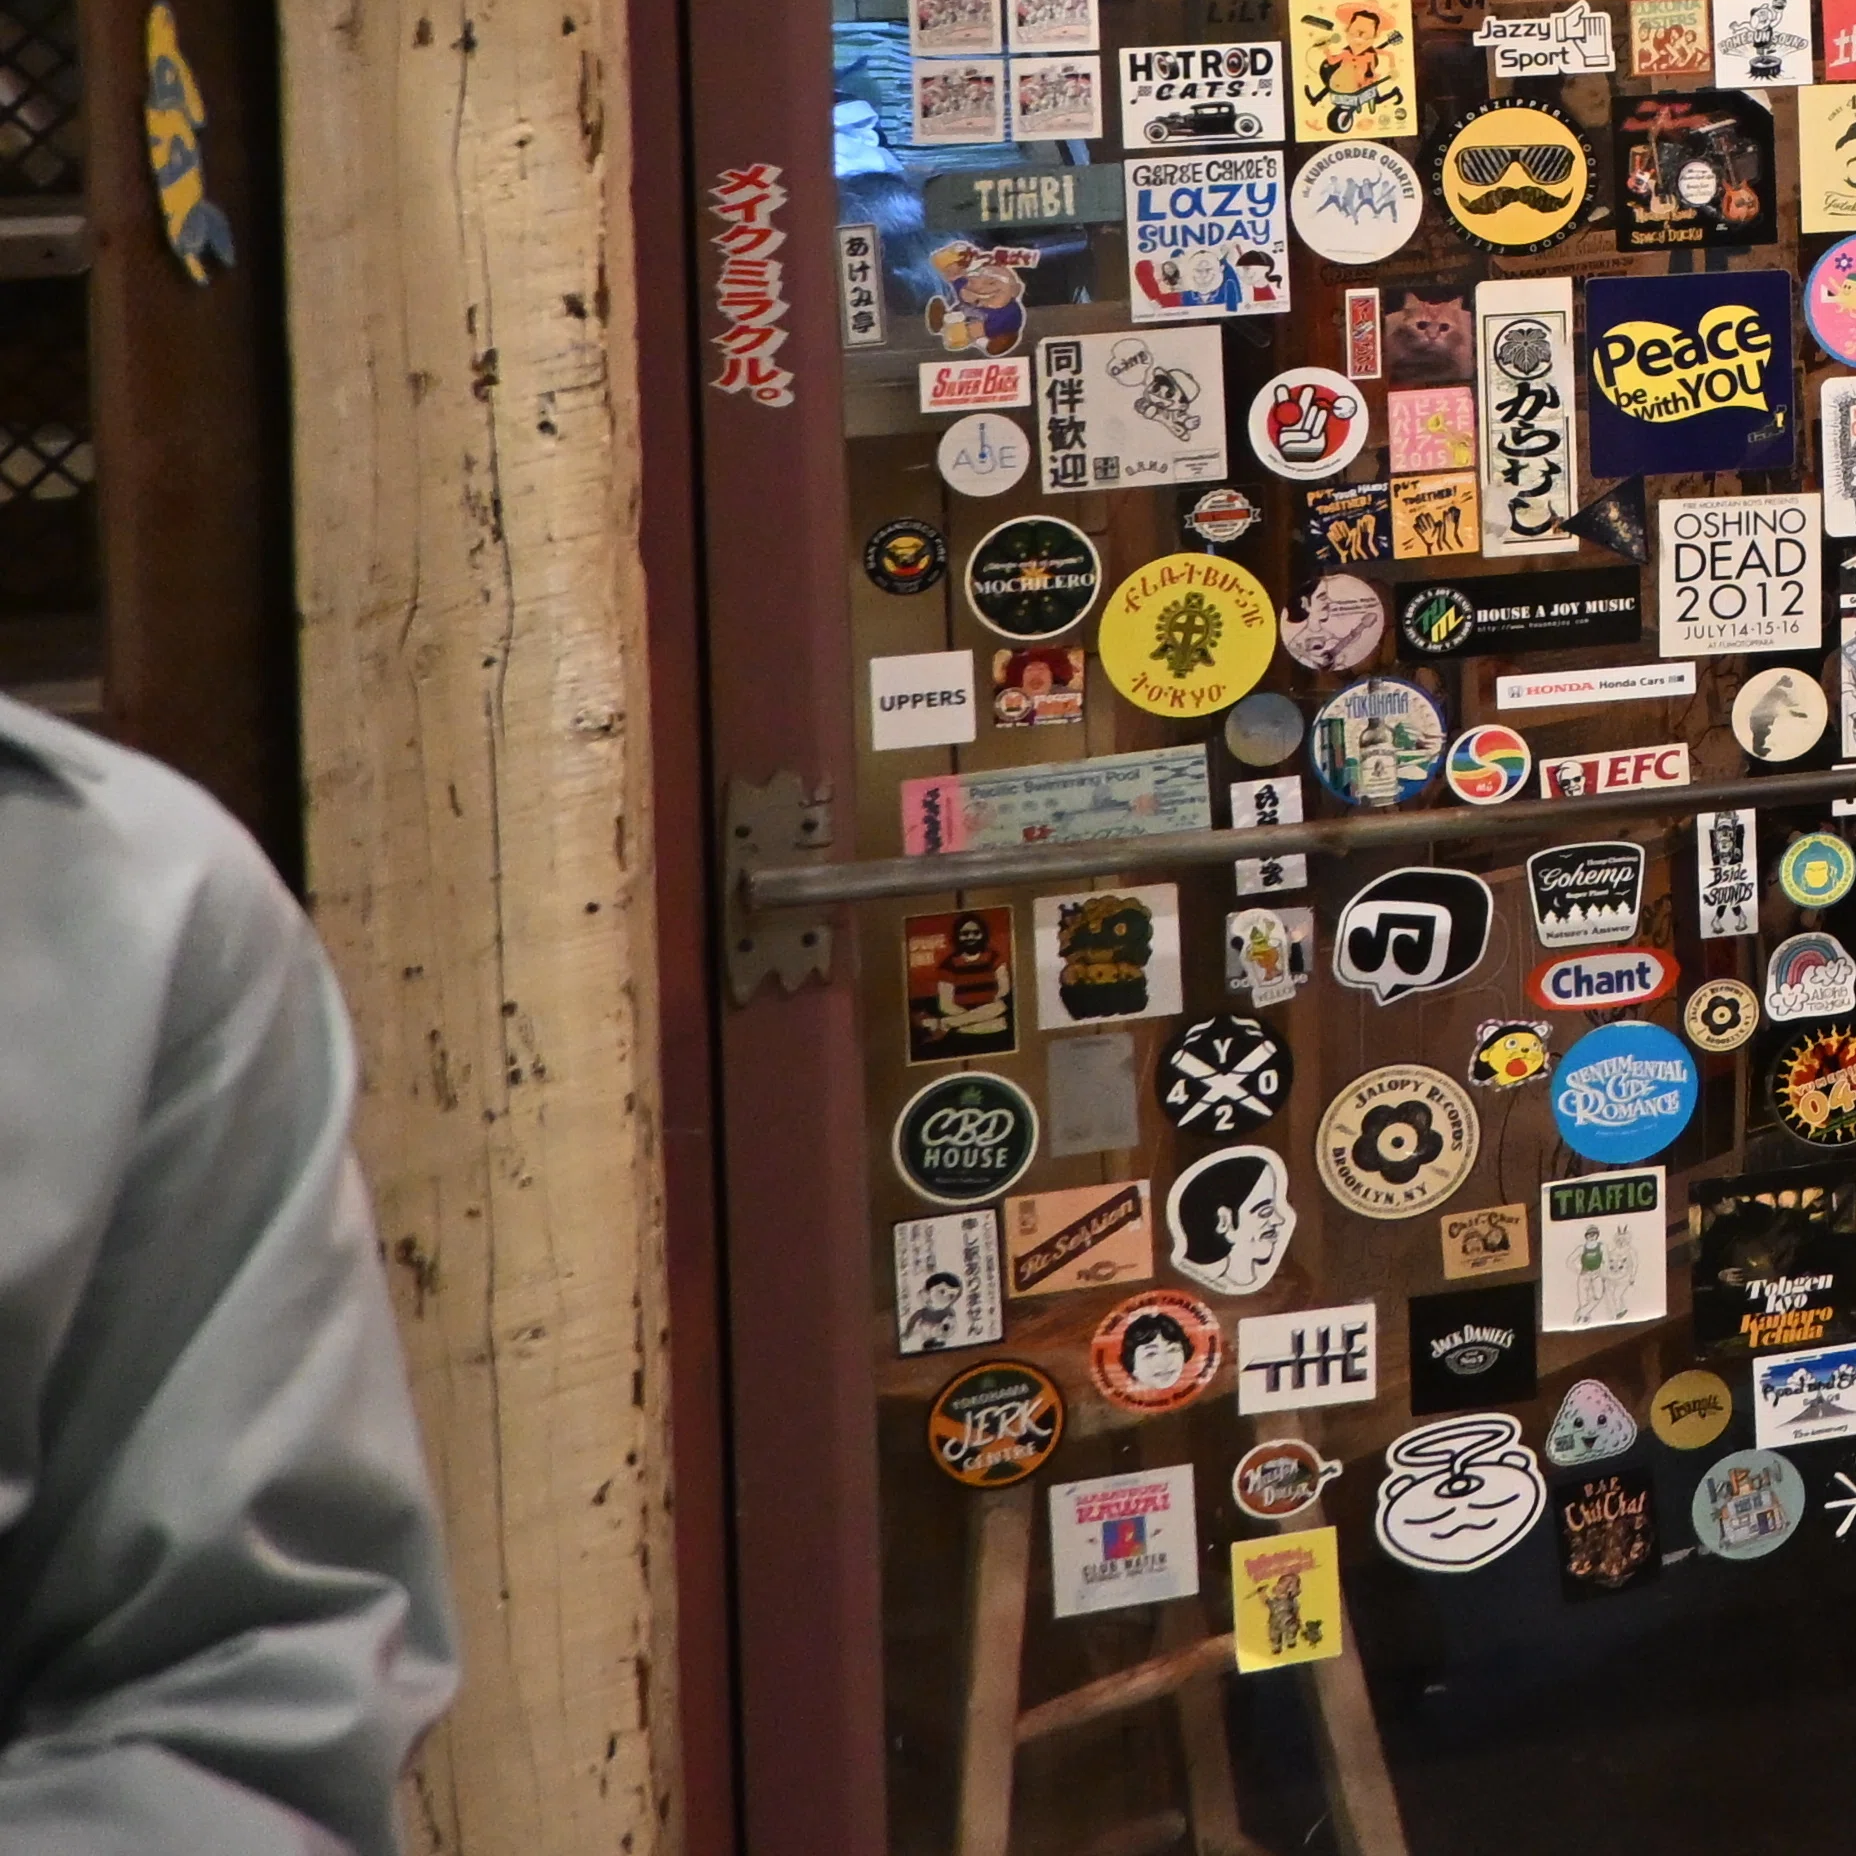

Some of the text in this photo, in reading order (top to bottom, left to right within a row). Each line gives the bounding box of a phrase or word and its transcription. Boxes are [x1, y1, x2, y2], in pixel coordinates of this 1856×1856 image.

[1479, 21, 1552, 41] Jazzy
[1129, 47, 1273, 82] HOT ROD
[1500, 46, 1570, 72] Sport
[1155, 81, 1247, 101] CATS
[973, 174, 1075, 221] TOMBI
[1138, 218, 1271, 253] SUNDAY
[710, 163, 795, 407] メイクミラクル。
[846, 236, 875, 334] あけみ亭
[1599, 315, 1771, 385] Peace
[1613, 358, 1769, 420] be with YOU
[1045, 340, 1089, 490] 同伴歓迎
[1673, 508, 1807, 540] OSHINO
[1673, 542, 1807, 583] DEAD
[974, 573, 1096, 596] MOCHILERO
[1675, 583, 1804, 621] 2012
[1476, 597, 1636, 622] HOUSE A JOY MUSIC
[879, 689, 966, 712] UPPERS
[1526, 677, 1665, 697] HONDA Honda Cars
[1604, 750, 1681, 788] EFC
[1539, 863, 1635, 891] Gohemp
[1552, 962, 1652, 998] Chant
[1559, 1087, 1680, 1126] ROMANCE
[923, 1148, 1008, 1169] HOUSE
[1554, 1180, 1656, 1216] TRAFFIC
[942, 1396, 1053, 1462] JERK
